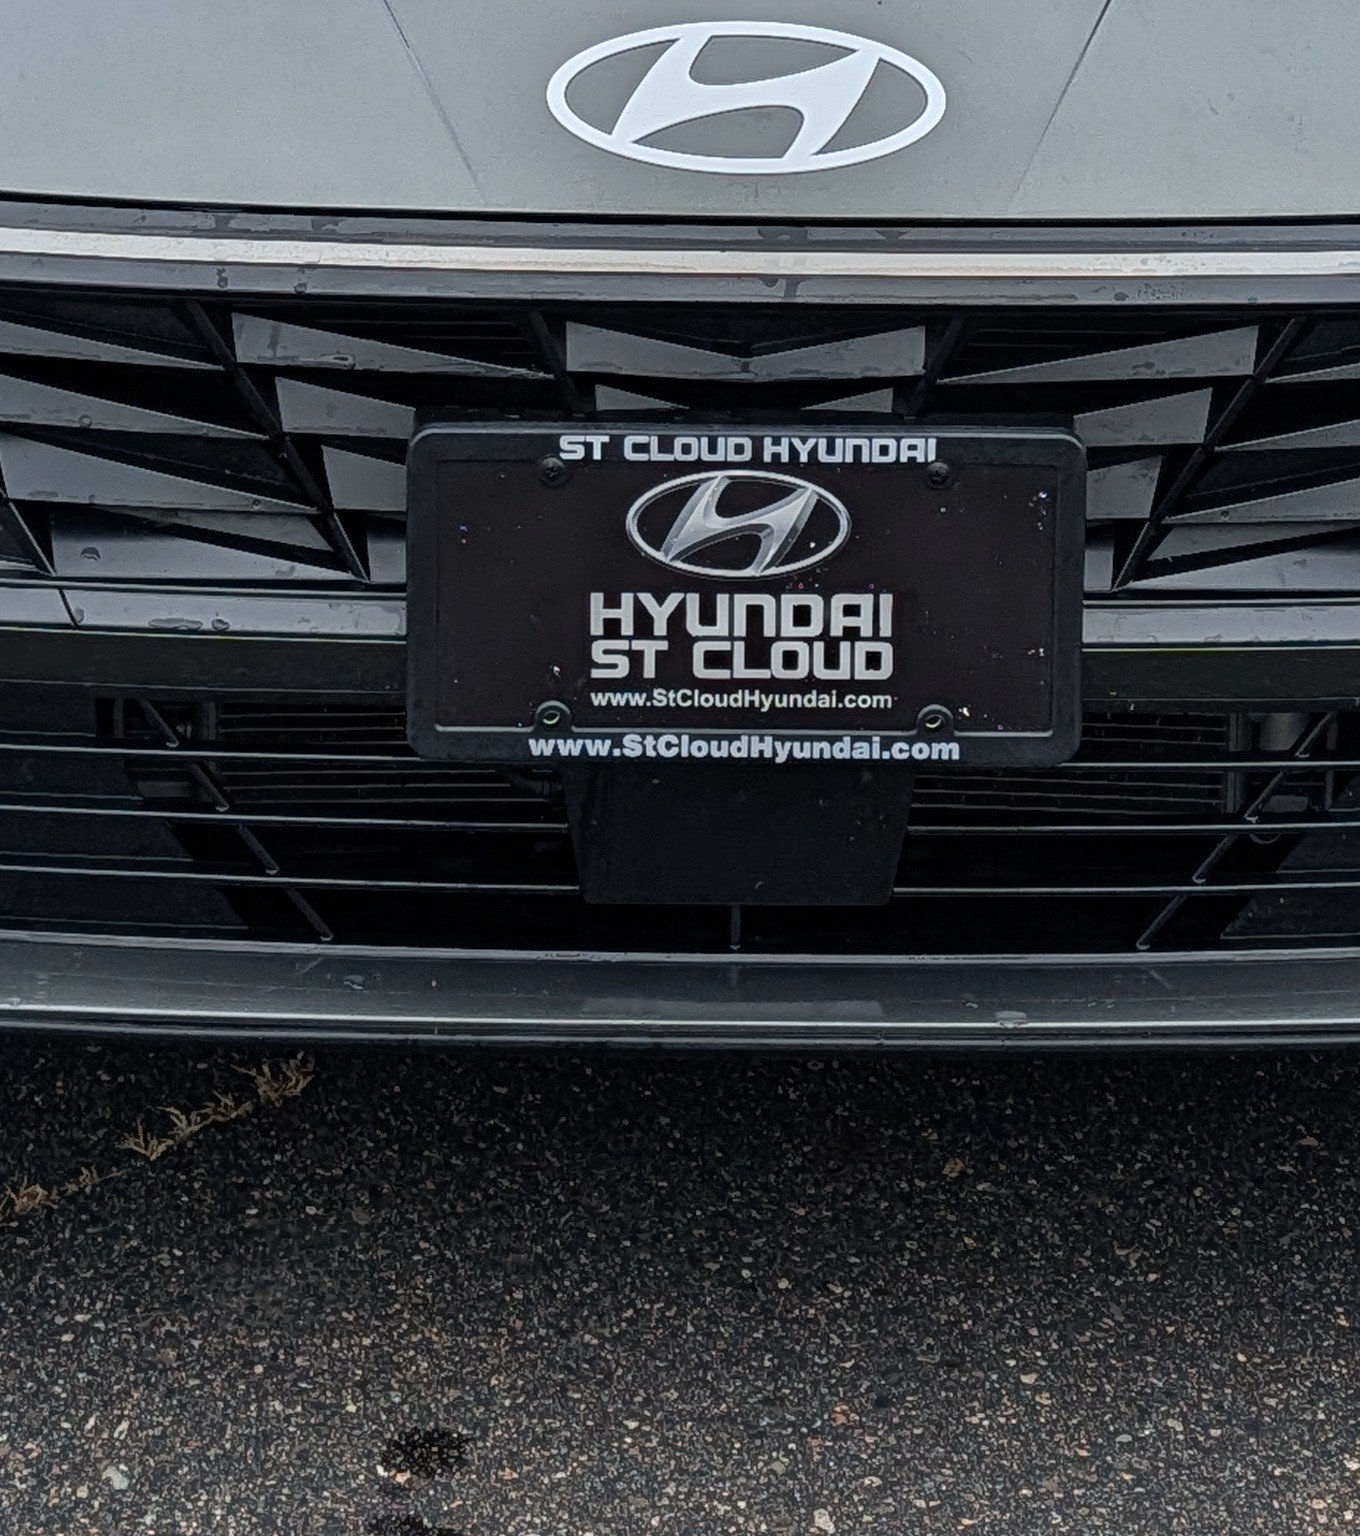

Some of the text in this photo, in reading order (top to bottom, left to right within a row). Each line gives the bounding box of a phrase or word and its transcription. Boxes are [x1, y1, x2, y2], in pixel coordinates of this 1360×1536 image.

[558, 435, 937, 463] ST CLOUD HYUNDAI
[589, 592, 893, 637] HYUNDAI
[590, 640, 894, 681] ST CLOUD
[590, 688, 893, 711] www.StCloudHyundai.com
[528, 734, 960, 763] www.StCloudHyundai.com
